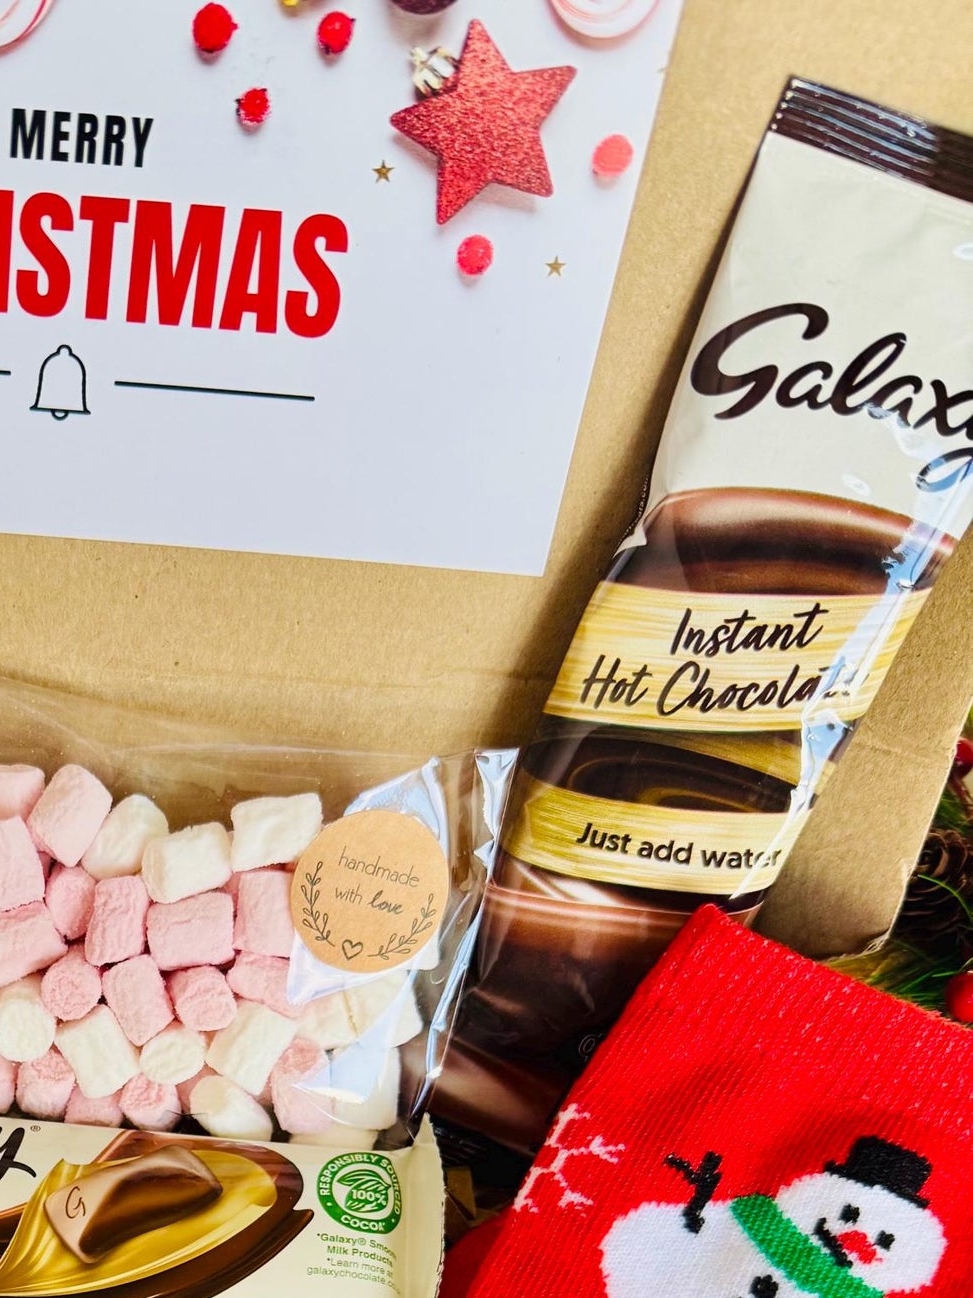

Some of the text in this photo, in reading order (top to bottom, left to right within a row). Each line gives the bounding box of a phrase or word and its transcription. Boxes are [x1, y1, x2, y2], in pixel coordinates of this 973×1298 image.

[10, 108, 154, 168] MERRY
[670, 602, 830, 657] Instant
[579, 654, 654, 710] Hot
[575, 821, 632, 855] Just
[636, 836, 694, 866] add
[337, 845, 421, 889] handmade
[334, 886, 404, 916] with love
[318, 1153, 379, 1197] RESPONSIBLY
[351, 1188, 388, 1206] 100%
[327, 1245, 349, 1256] Milk
[362, 1261, 386, 1275] more
